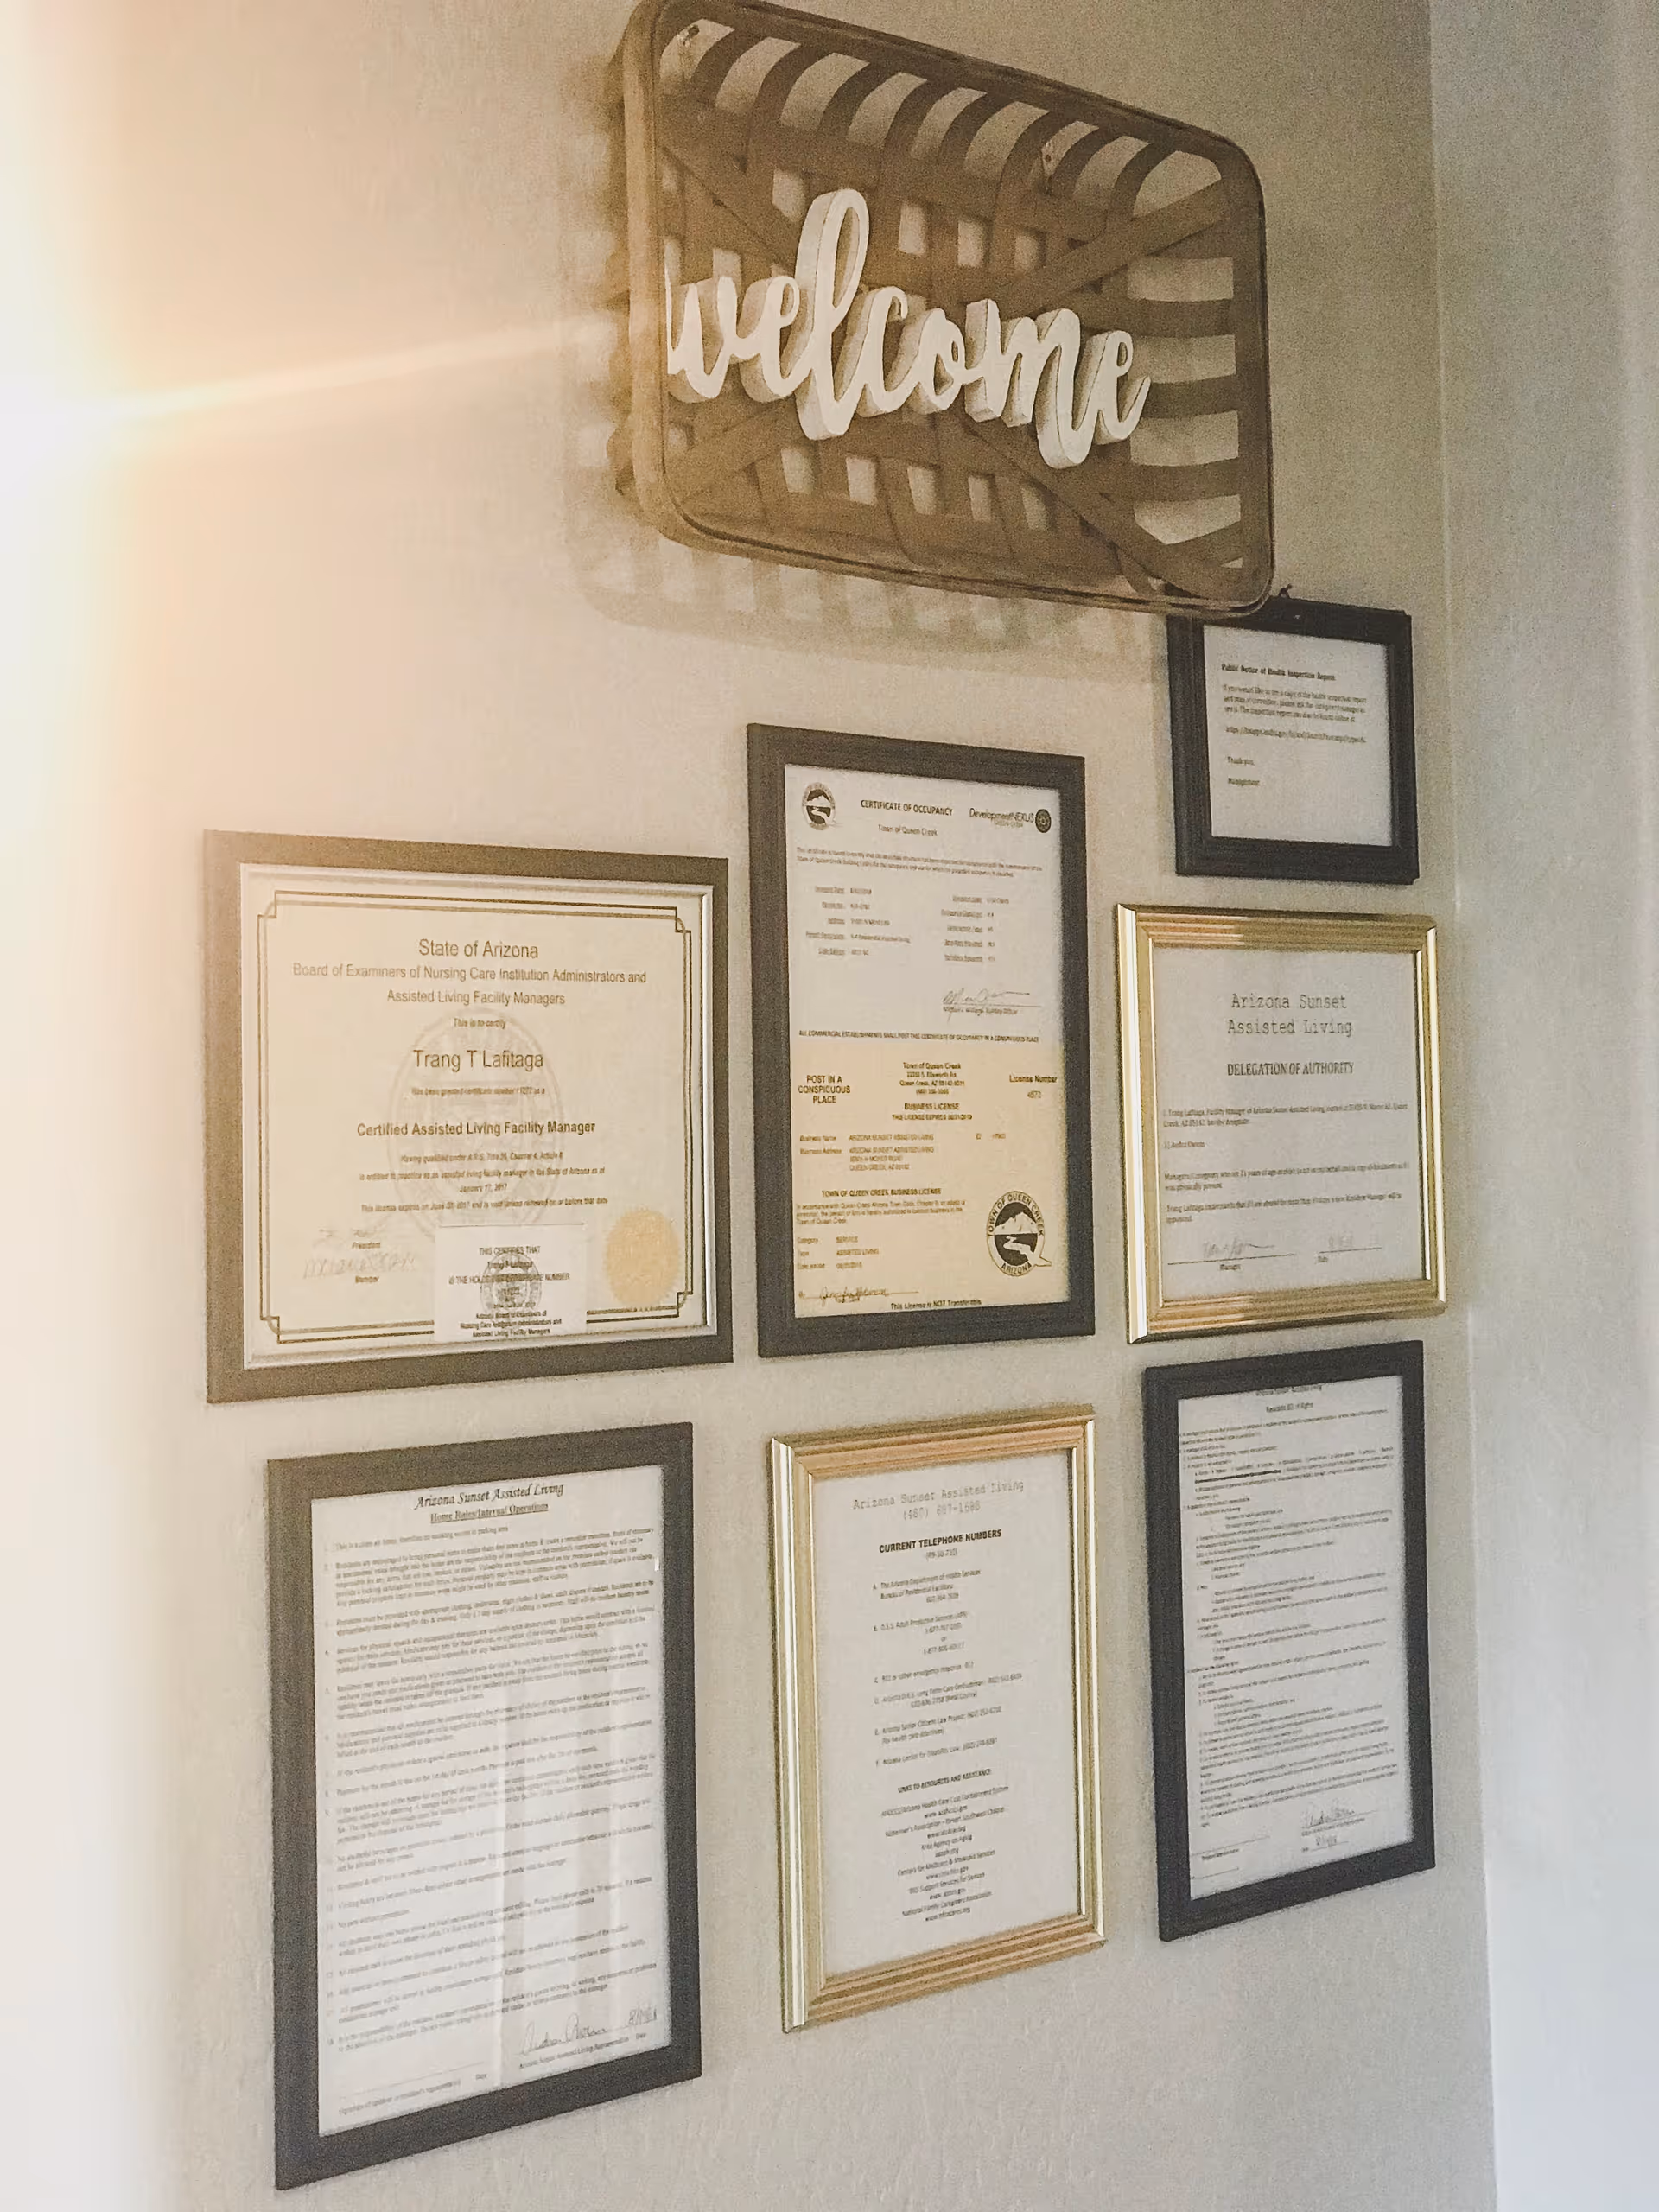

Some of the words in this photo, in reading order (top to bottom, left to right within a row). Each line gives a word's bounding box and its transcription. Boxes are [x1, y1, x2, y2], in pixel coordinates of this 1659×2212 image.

[665, 188, 1151, 468] welcome
[860, 799, 901, 812] CERTIFICATE
[903, 803, 912, 813] OF
[913, 804, 954, 817] OCCUPANCY
[418, 938, 459, 957] State
[463, 940, 479, 957] of
[482, 940, 539, 959] Arizona
[292, 962, 328, 976] Board
[332, 963, 344, 977] of
[346, 963, 407, 979] Examiners
[410, 965, 421, 979] of
[423, 965, 467, 982] Nursing
[469, 966, 496, 981] Care
[499, 968, 550, 982] Institution
[552, 969, 626, 983] Administrators
[628, 970, 647, 983] and
[386, 988, 435, 1003] Assisted
[438, 989, 470, 1007] Living
[474, 990, 511, 1007] Facility
[513, 991, 566, 1008] Managers
[1231, 993, 1290, 1009] Arizona
[1300, 994, 1348, 1009] Sunset
[454, 1017, 468, 1027] This
[469, 1019, 476, 1027] is
[477, 1019, 485, 1027] to
[1227, 1018, 1295, 1034] Assisted
[1302, 1018, 1352, 1038] Living
[412, 1049, 461, 1073] Trang
[467, 1049, 478, 1069] T
[482, 1049, 543, 1072] Lafitaga
[1227, 1063, 1288, 1077] DELEGATION
[1288, 1062, 1301, 1076] OF
[1302, 1061, 1355, 1075] AUTHORITY
[806, 1074, 826, 1084] POST
[828, 1075, 836, 1084] IN
[836, 1075, 842, 1084] A
[1009, 1074, 1033, 1084] License
[1034, 1075, 1058, 1084] Number
[798, 1084, 851, 1094] CONSPICUOUS
[812, 1095, 837, 1104] PLACE
[357, 1122, 409, 1137] Certified
[411, 1122, 463, 1136] Assisted
[467, 1122, 500, 1137] Living
[504, 1121, 545, 1136] Facility
[547, 1121, 596, 1135] Manager
[849, 1189, 869, 1198] QUEEN
[988, 1209, 999, 1237] TOWN
[996, 1198, 1006, 1210] OF
[1007, 1193, 1033, 1206] QUEEN
[1031, 1205, 1045, 1236] CREEK
[479, 1247, 493, 1255] THIS
[525, 1245, 541, 1254] THAT
[1001, 1262, 1033, 1274] ARIZONA
[891, 1302, 903, 1311] This
[904, 1301, 926, 1310] License
[932, 1300, 946, 1308] NOT
[414, 1494, 455, 1510] Arizona
[457, 1491, 491, 1505] Sunset
[491, 1483, 533, 1502] Assisted
[533, 1483, 564, 1497] Living
[852, 1497, 895, 1510] Arizona
[900, 1493, 936, 1504] Sunset
[941, 1485, 986, 1500] Assisted
[990, 1480, 1024, 1494] Living
[430, 1512, 453, 1522] Home
[509, 1503, 549, 1514] Operations
[879, 1540, 917, 1554] CURRENT
[918, 1533, 963, 1548] TELEPHONE
[965, 1528, 1002, 1541] NUMBERS
